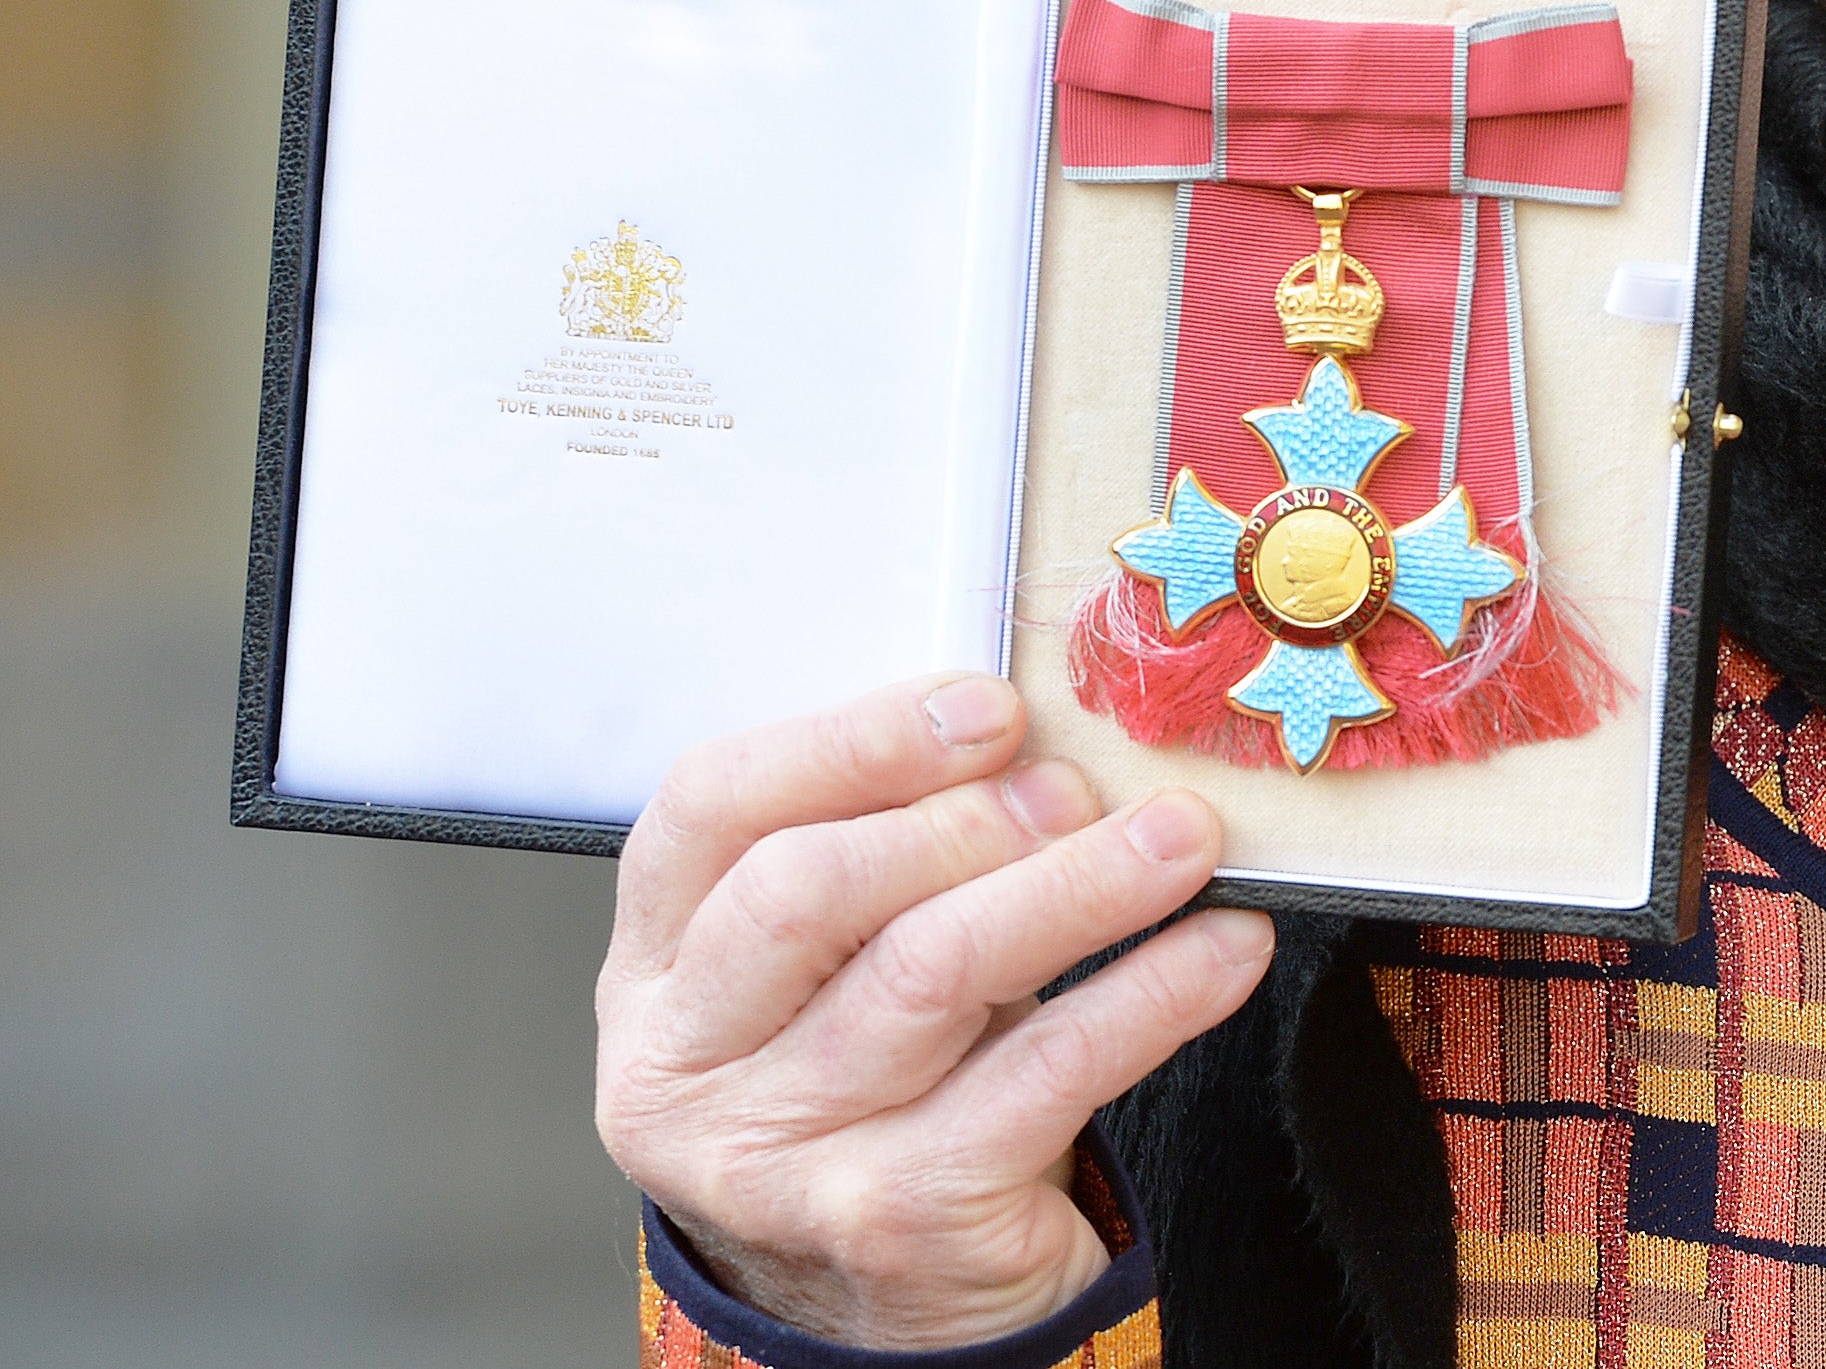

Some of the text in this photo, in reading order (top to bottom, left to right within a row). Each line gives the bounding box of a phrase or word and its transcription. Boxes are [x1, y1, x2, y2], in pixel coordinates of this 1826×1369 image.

[560, 346, 679, 364] BY APPOINTMENT TO
[544, 357, 694, 379] HER MAJESTY THE QUEEN
[524, 369, 711, 393] SUPPLIERS OF GOLD AND SILVER
[561, 386, 612, 399] INSIGNIA
[612, 389, 637, 401] AND
[640, 391, 717, 407] EMBROIDERY
[546, 404, 613, 421] KENNING
[617, 408, 627, 422] &
[632, 410, 702, 428] SPENCER
[707, 414, 735, 430] LTD
[590, 426, 639, 439] LONDON
[567, 442, 628, 457] FOUNDED
[1236, 517, 1267, 574] GOD
[1277, 487, 1331, 516] AND
[1341, 497, 1385, 544] THE
